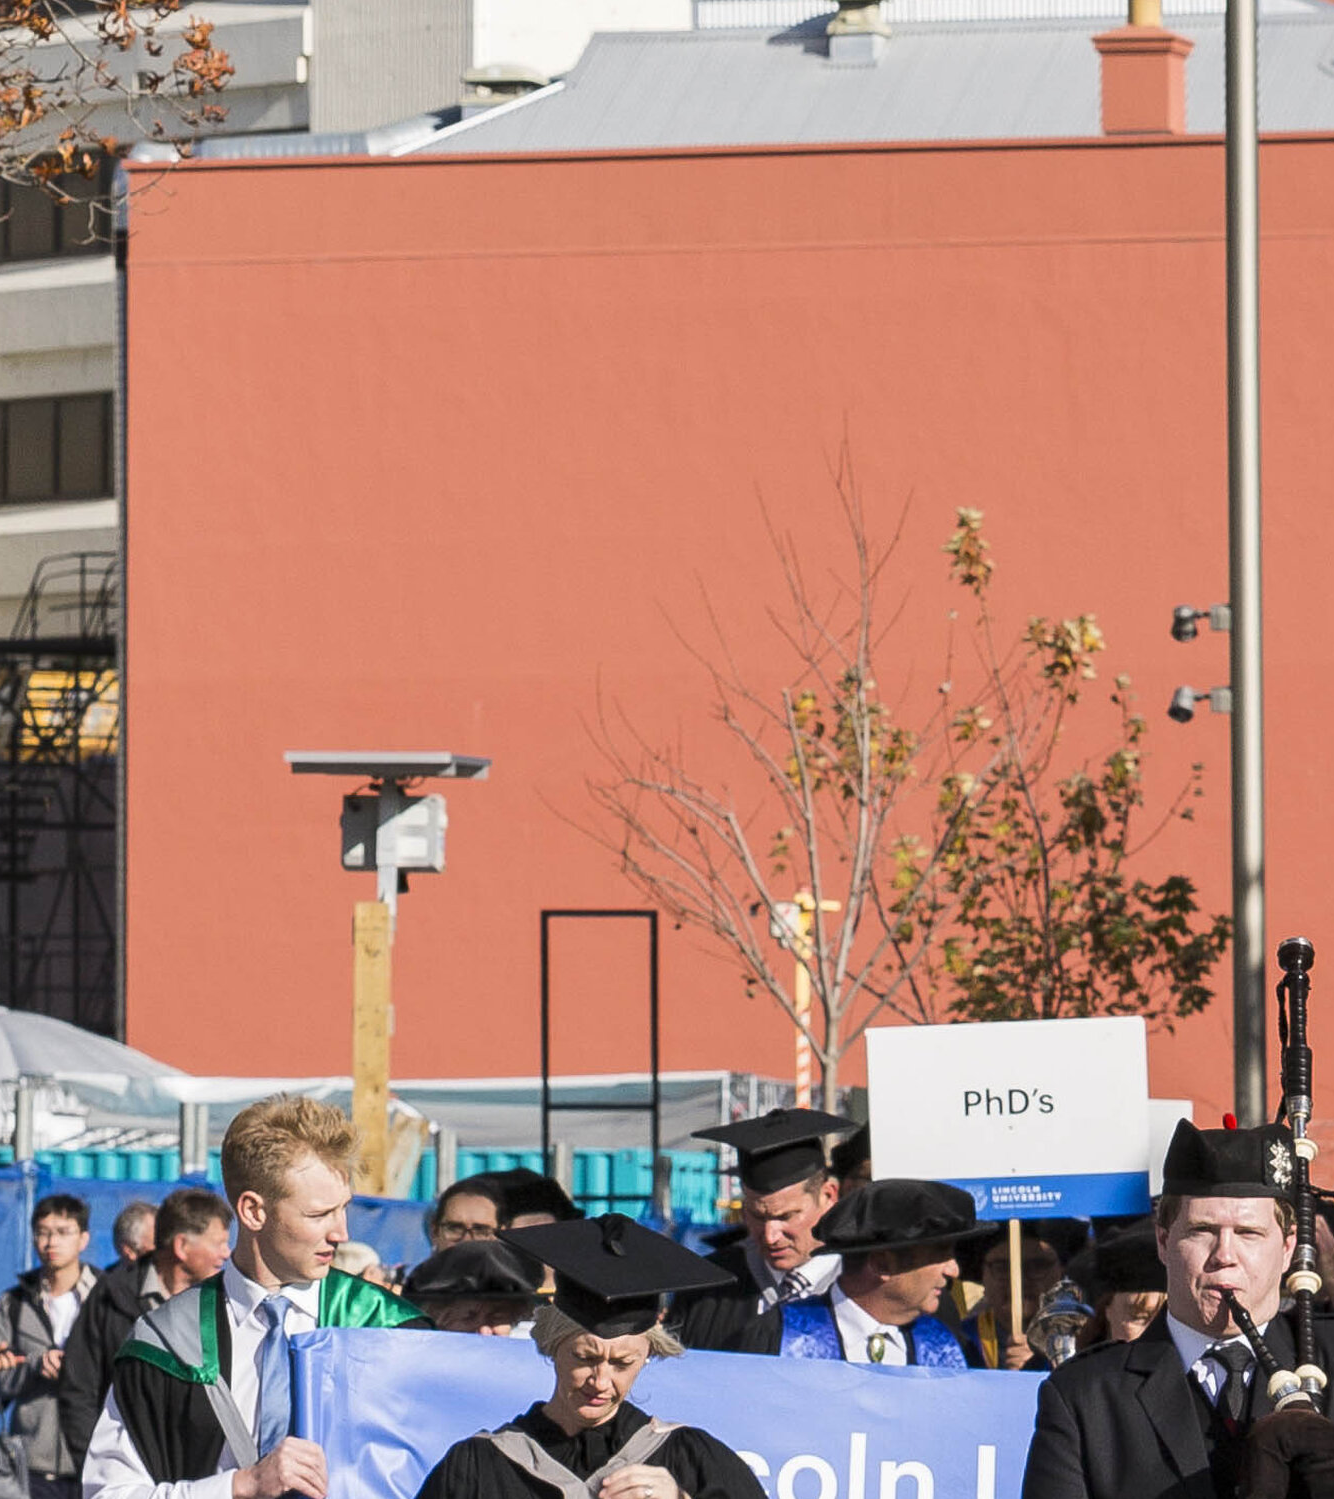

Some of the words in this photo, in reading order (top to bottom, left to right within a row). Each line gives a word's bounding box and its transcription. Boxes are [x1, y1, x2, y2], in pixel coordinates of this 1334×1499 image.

[964, 1087, 1054, 1116] PhD's
[992, 1185, 1041, 1195] LINCOLN
[992, 1192, 1062, 1202] UNIVERSITY
